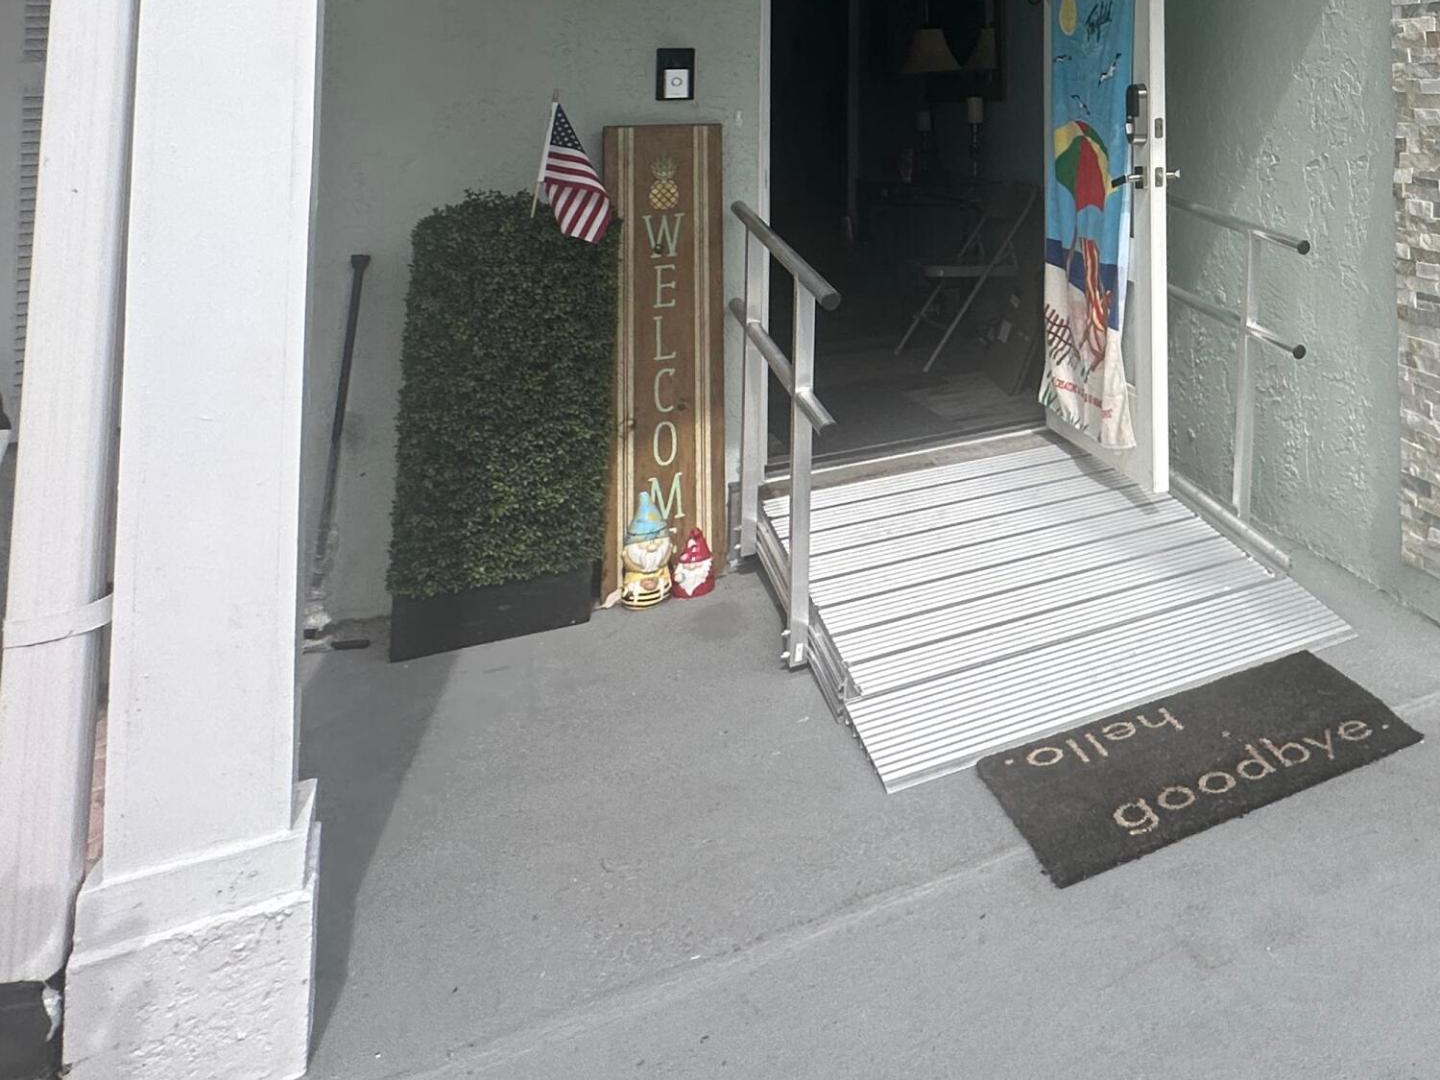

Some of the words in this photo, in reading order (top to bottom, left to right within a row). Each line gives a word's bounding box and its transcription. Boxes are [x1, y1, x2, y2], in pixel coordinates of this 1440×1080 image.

[642, 211, 685, 554] WELCOM
[1004, 707, 1184, 767] hello.
[1113, 719, 1391, 835] goodbye.
